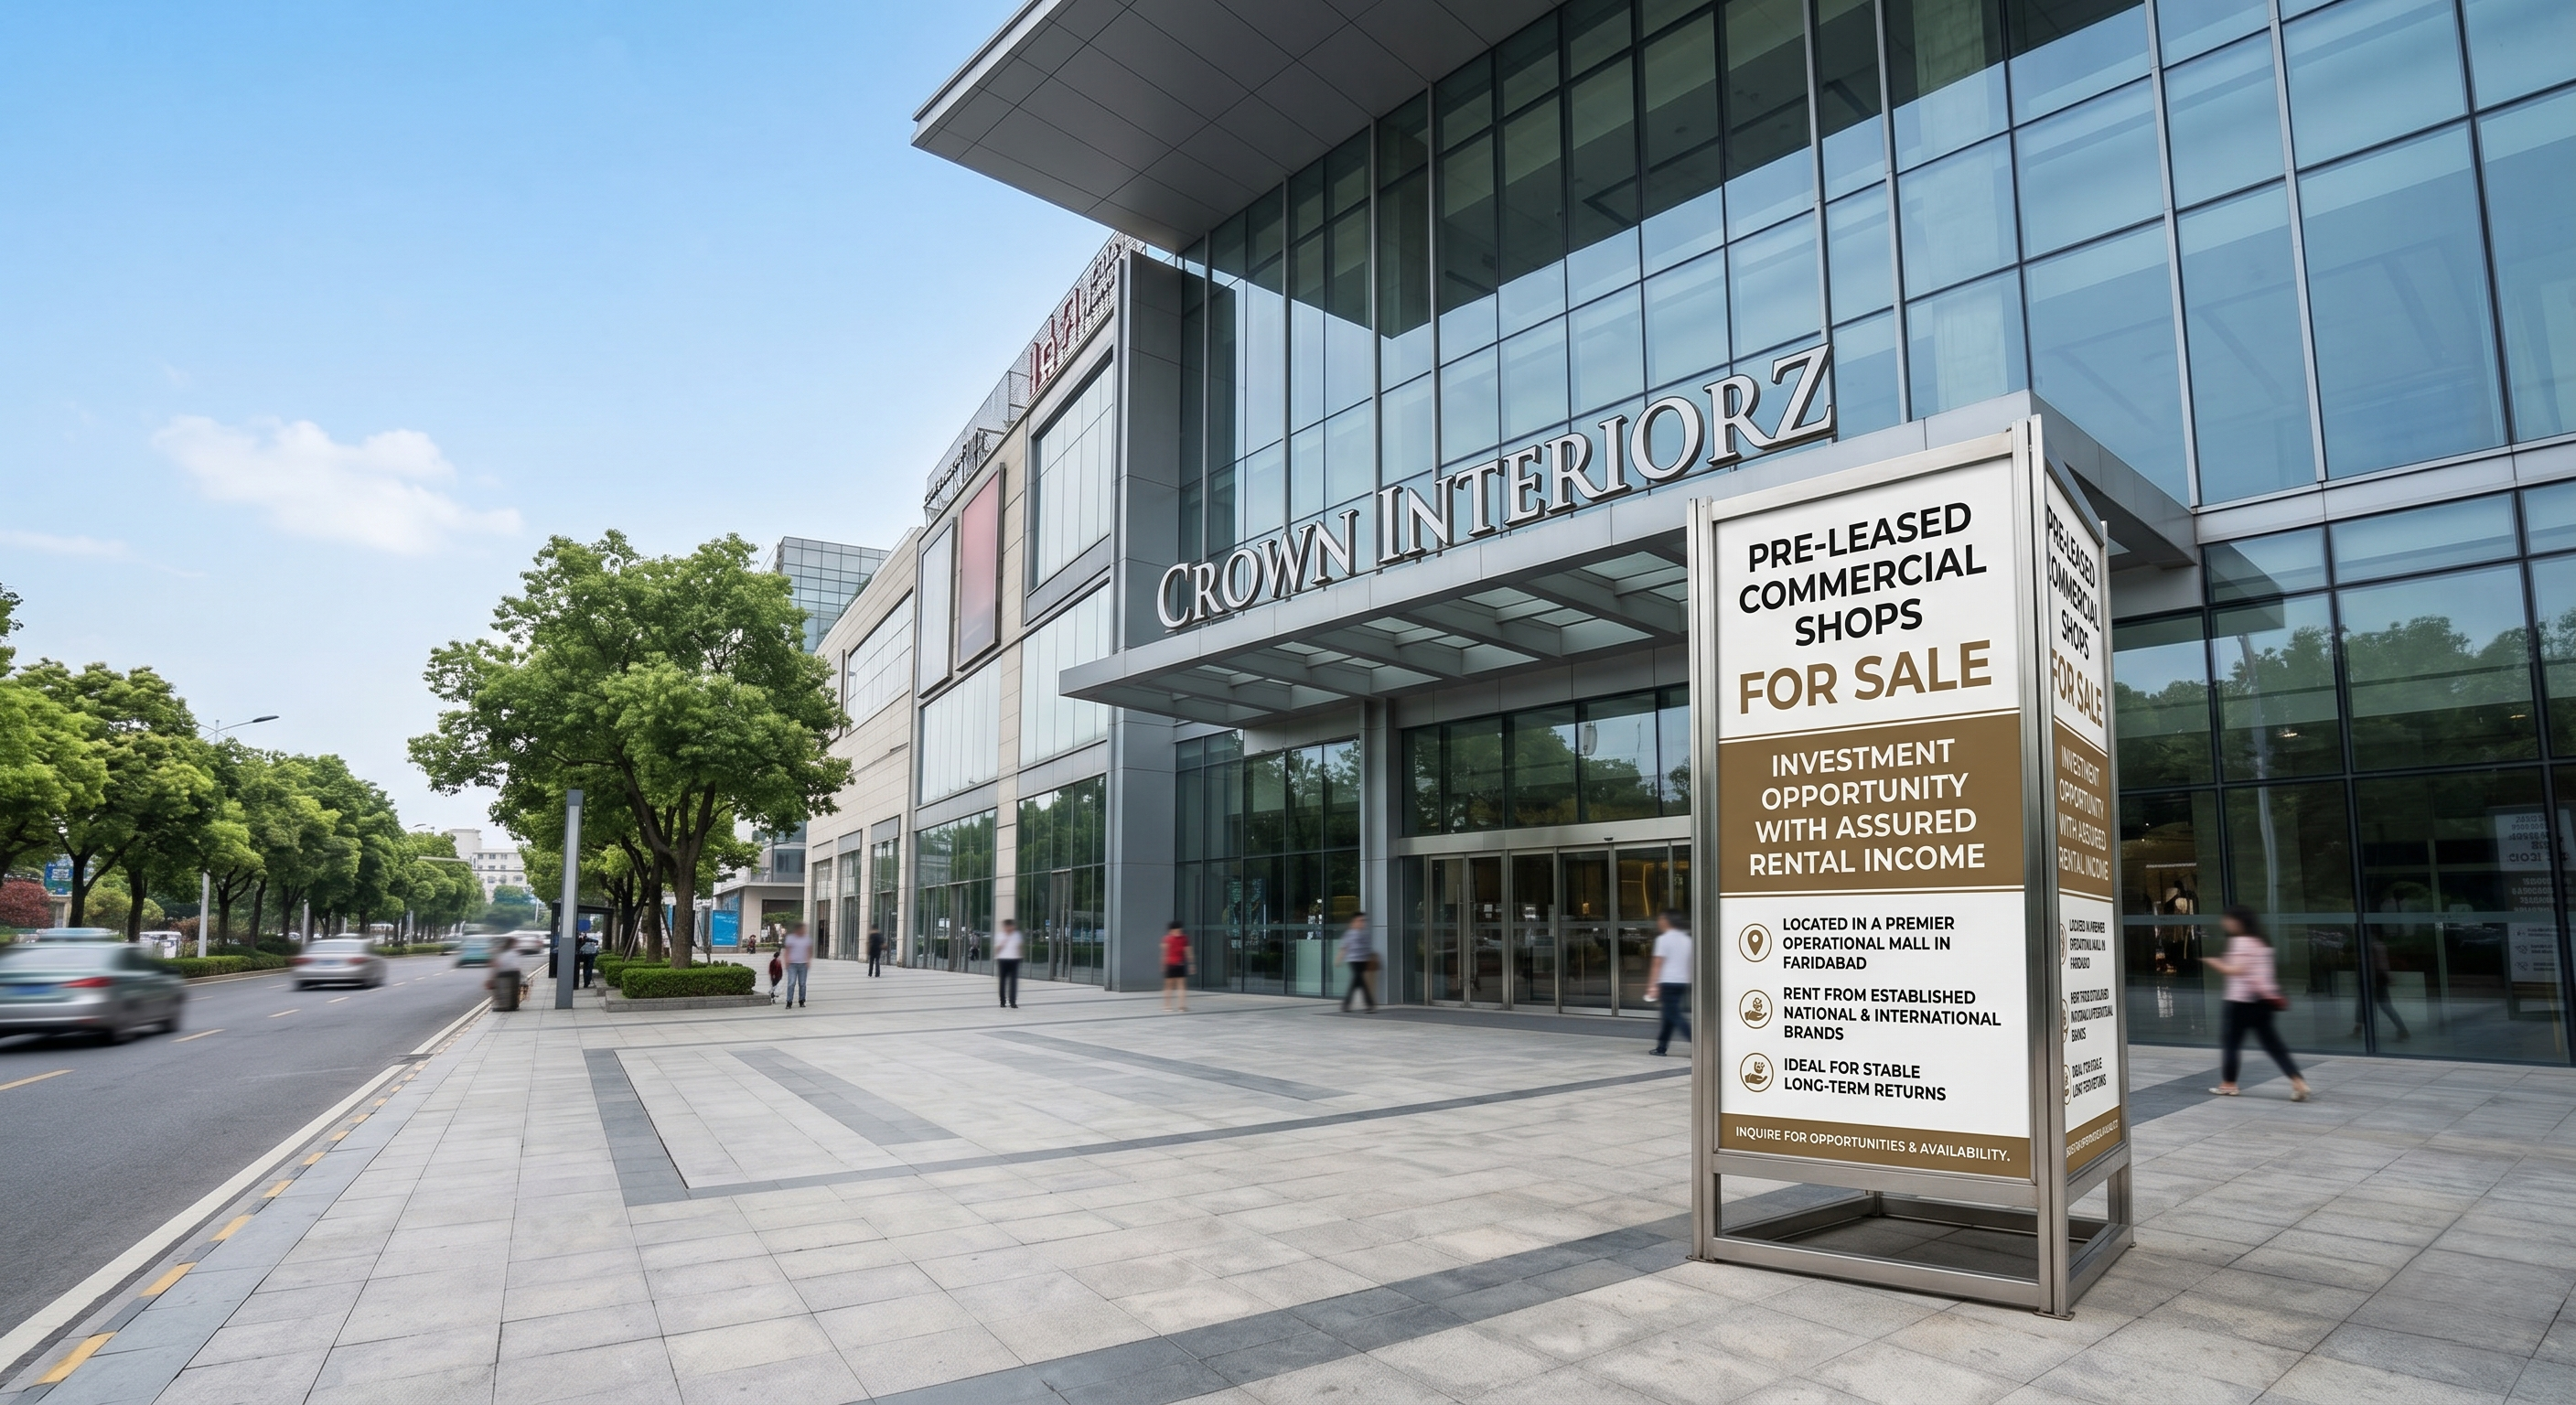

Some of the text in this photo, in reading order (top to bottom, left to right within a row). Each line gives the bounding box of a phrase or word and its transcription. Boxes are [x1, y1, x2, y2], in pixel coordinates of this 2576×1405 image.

[1157, 344, 1836, 629] CROWN INTERIORZ
[1749, 502, 1971, 574] PRE-LEASED
[2047, 504, 2095, 588] PRE-LEASED
[1739, 543, 1987, 614] COMMERCIAL
[2049, 552, 2099, 632] OMMERCIAL
[1795, 597, 1923, 647] SHOPS
[2062, 609, 2088, 660] SHOPS
[1740, 639, 1992, 715] FOR SALE
[2052, 649, 2103, 728] FOR SALE
[1772, 737, 1956, 778] INVESTMENT
[1761, 772, 1970, 810] OPPORTUNITY
[1755, 808, 1977, 843] WITH ASSURED
[2059, 812, 2077, 840] WITH
[1750, 842, 1985, 876] RENTAL INCOME
[2059, 846, 2108, 880] RENTAL INCOME
[1783, 916, 1955, 931] LOCATED IN A PREMIER
[1782, 936, 1950, 950] OPERATIONAL MALL IN
[1783, 956, 1867, 971] FARIDABAD
[1783, 986, 1976, 1004] RENT FROM ESTABLISHED
[1784, 1005, 2002, 1026] NATIONAL & INTERNATIONAL
[1784, 1024, 1844, 1041] BRANDS
[1784, 1057, 1921, 1079] IDEAL FOR STABLE
[1784, 1077, 1947, 1101] LONG-TERM RETURNS
[1735, 1126, 2011, 1162] INQUIRE FOR OPPORTUNITIES & AVAILABILITY.
